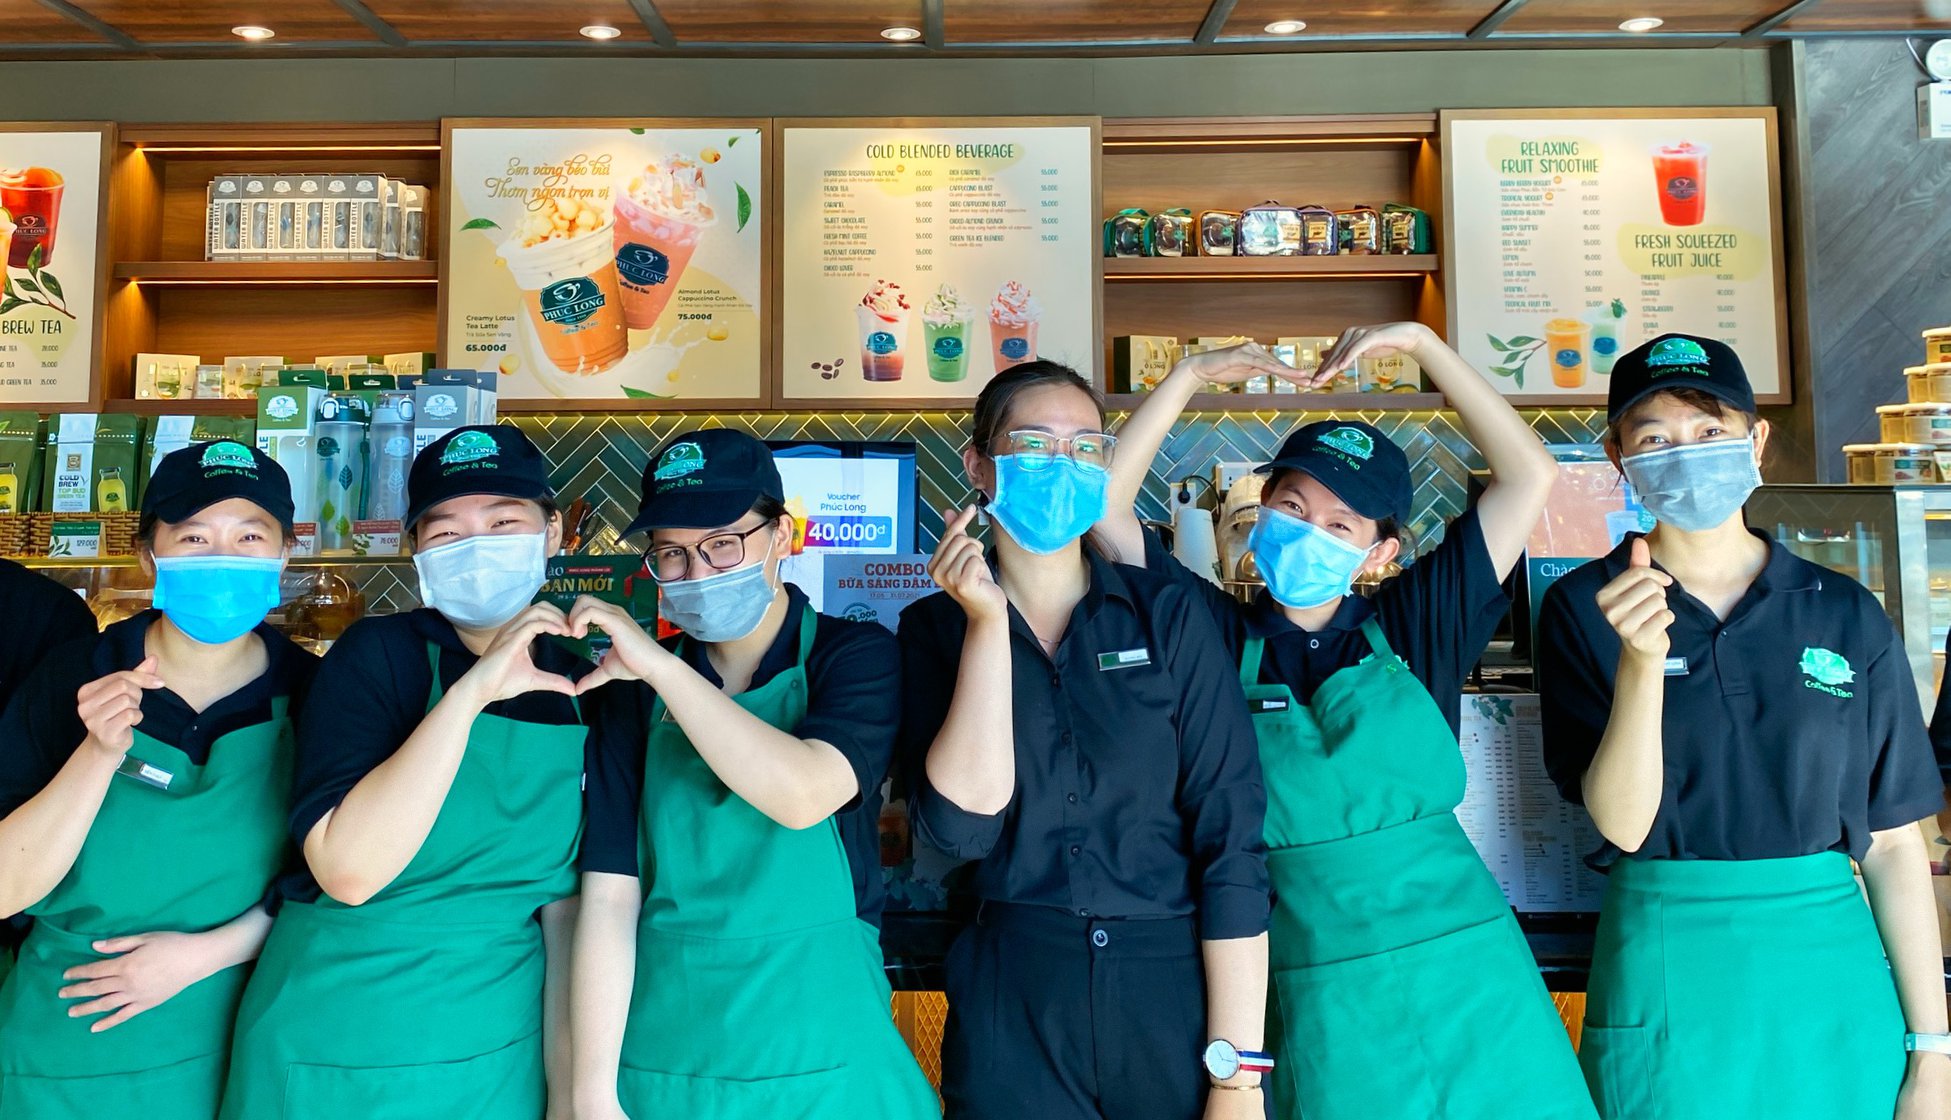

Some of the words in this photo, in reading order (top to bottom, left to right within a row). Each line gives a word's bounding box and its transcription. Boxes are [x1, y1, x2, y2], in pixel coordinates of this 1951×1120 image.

[866, 144, 894, 158] COLD
[900, 144, 950, 158] BLENDED
[956, 144, 1014, 158] BEVERAGE
[1521, 142, 1579, 156] RELAXING
[507, 157, 528, 176] Sen
[533, 163, 568, 187] vàng
[564, 154, 588, 175] béo
[1501, 159, 1533, 173] FRUIT
[1540, 159, 1599, 173] SMOOTHIE
[485, 177, 528, 205] Thơm
[527, 187, 565, 211] ngon
[1635, 234, 1671, 248] FRESH
[1676, 234, 1737, 248] SQUEEZED
[1652, 253, 1684, 267] FRUIT
[1690, 253, 1722, 267] JUICE
[615, 258, 638, 274] PHUC
[640, 267, 666, 283] LONG
[543, 306, 571, 321] PHUC
[574, 296, 604, 313] LONG
[2, 320, 34, 334] BREW
[40, 320, 62, 334] TEA
[470, 447, 498, 455] LONG
[481, 461, 498, 469] Tea
[1346, 457, 1360, 470] Tea
[827, 493, 861, 501] Voucher
[820, 502, 843, 511] Phúc
[844, 503, 867, 513] Long
[864, 563, 925, 576] COMBO
[577, 574, 614, 591] MỚI
[838, 577, 864, 588] BỮA
[867, 577, 900, 588] SÁNG
